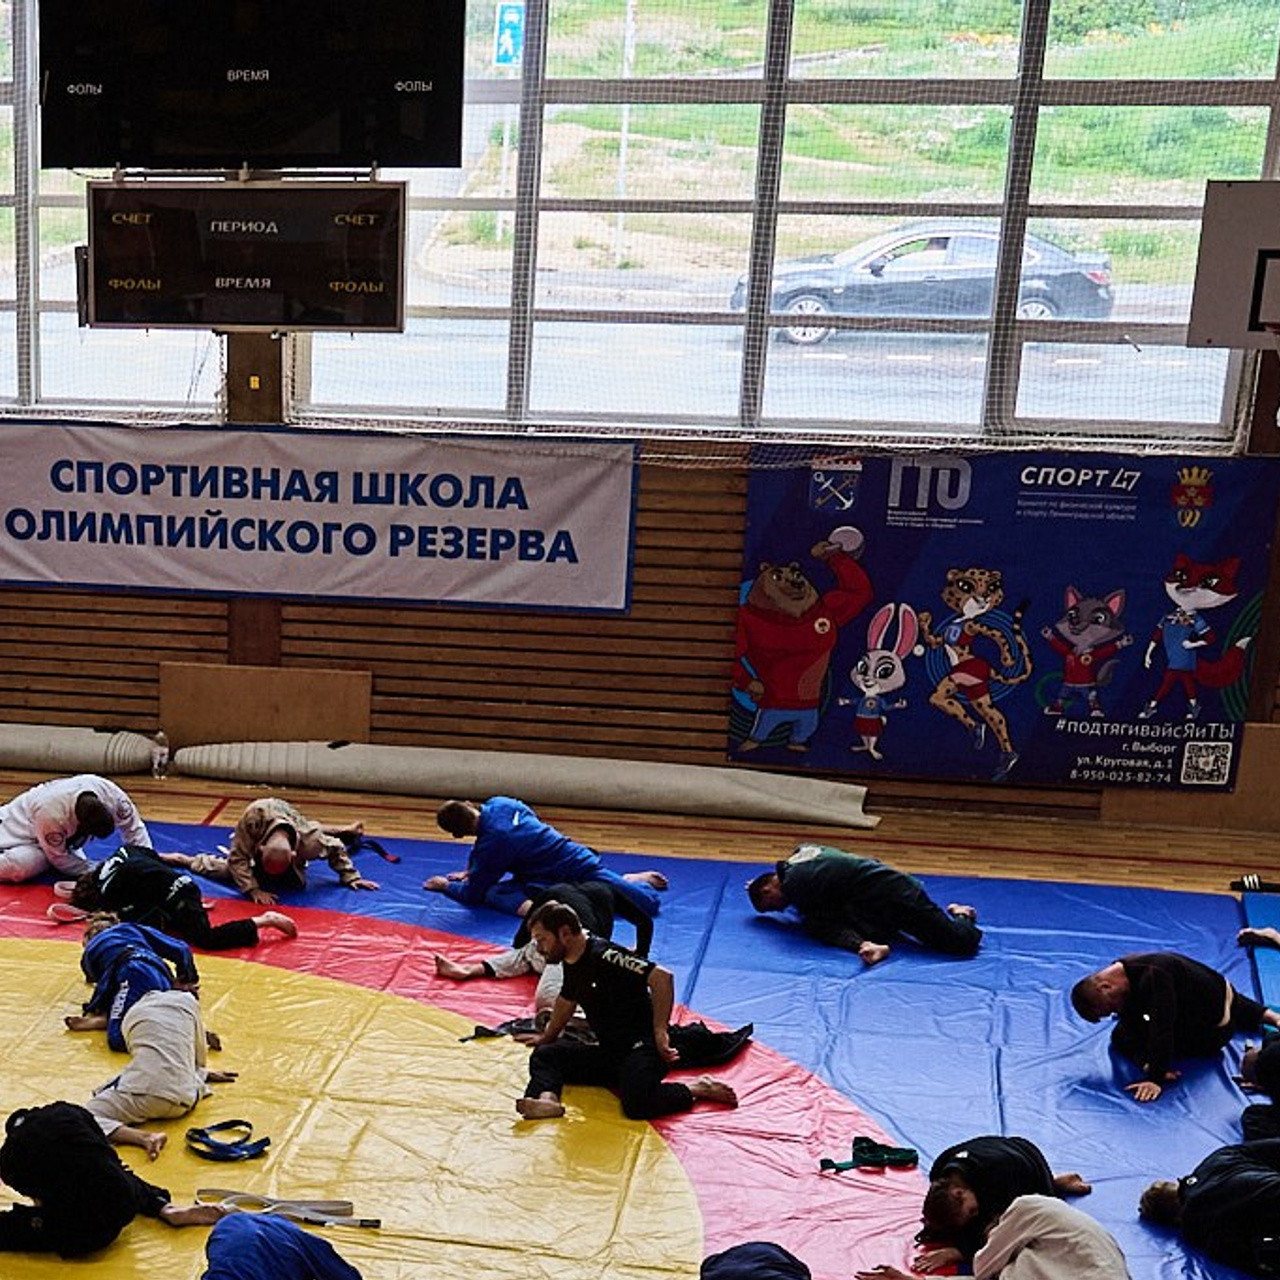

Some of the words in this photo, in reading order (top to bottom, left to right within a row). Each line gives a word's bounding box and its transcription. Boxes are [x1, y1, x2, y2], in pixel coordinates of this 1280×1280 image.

[227, 70, 269, 81] ВРЕМЯ
[67, 83, 102, 95] ФОЛЫ
[394, 81, 432, 92] ФОЛЫ
[112, 213, 152, 224] СЧЕТ
[334, 214, 378, 226] СЧЕТ
[211, 221, 278, 233] ПЕРИОД
[108, 278, 161, 290] ФОЛЫ
[215, 277, 270, 289] ВРЕМЯ
[329, 281, 384, 293] ФОЛЫ
[1020, 466, 1109, 487] СПОРТ
[50, 459, 339, 503] СПОРТИВНАЯ
[352, 471, 529, 510] ШКОЛА
[5, 508, 377, 556] ОЛИМПИЙСКОГО
[389, 523, 579, 563] РЕЗЕРВА
[1131, 741, 1178, 755] Выборг
